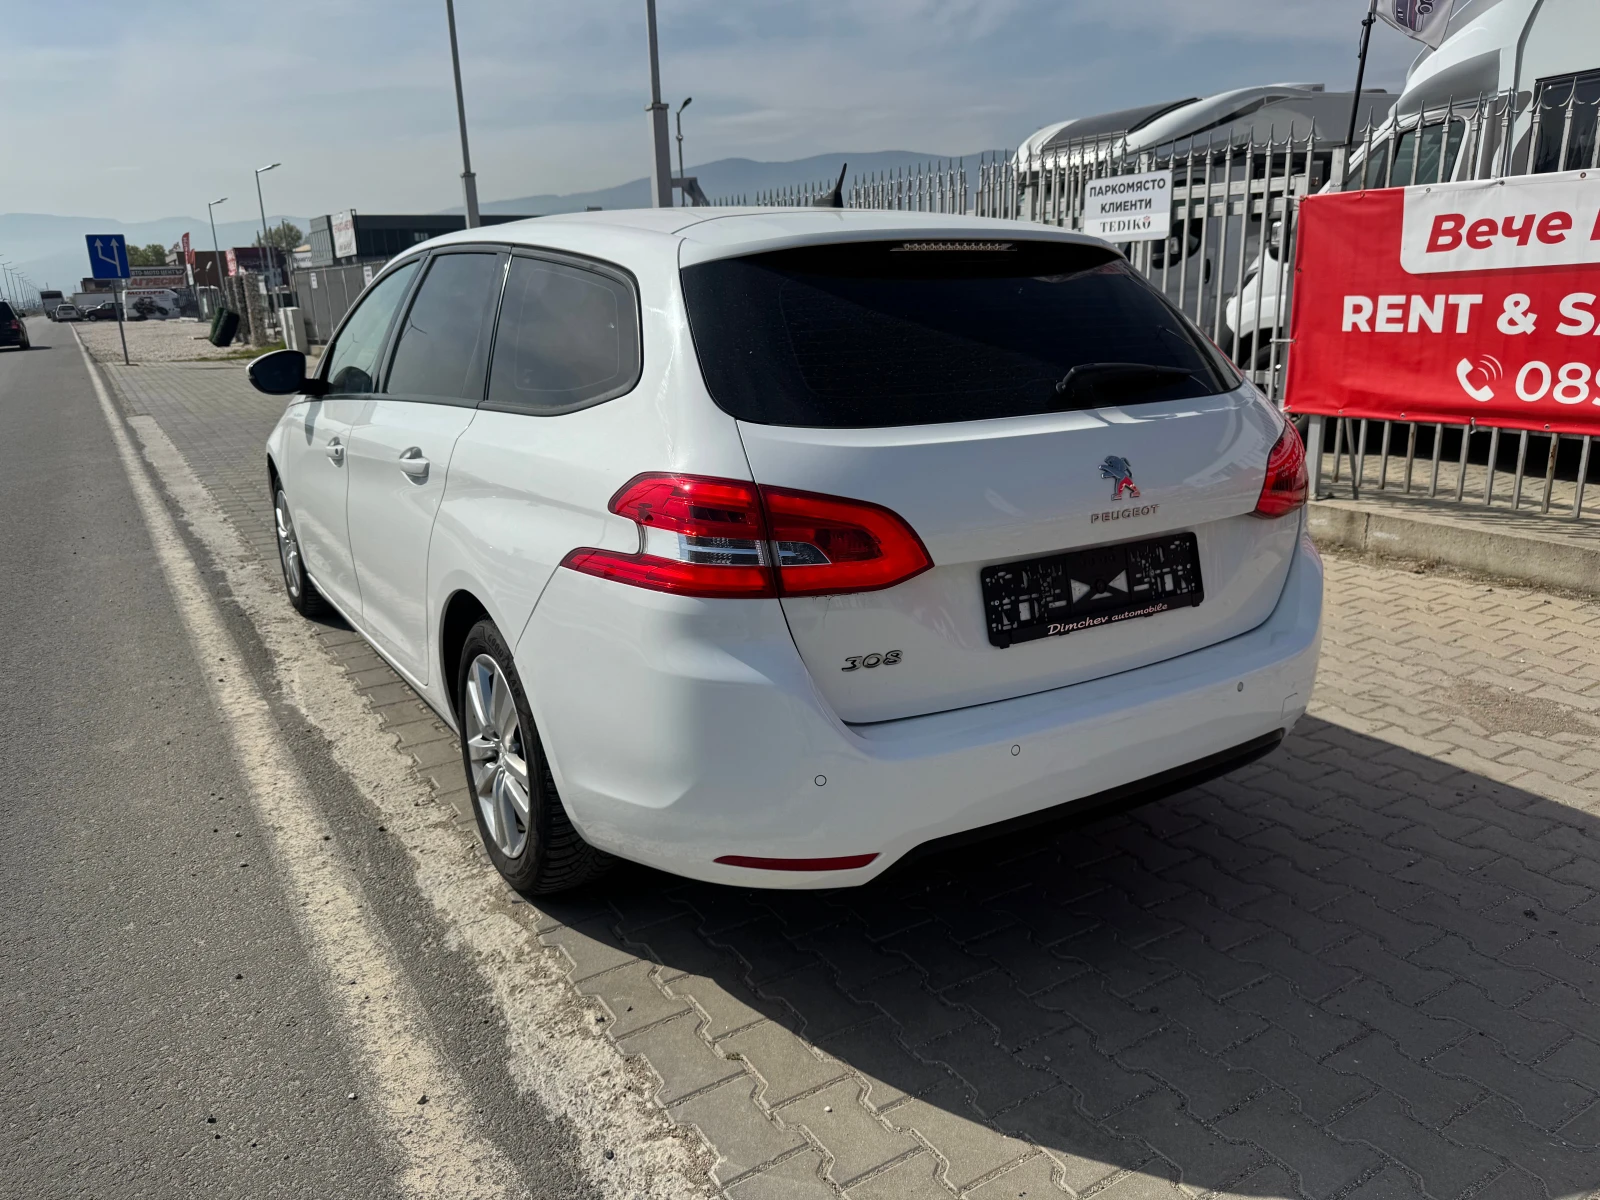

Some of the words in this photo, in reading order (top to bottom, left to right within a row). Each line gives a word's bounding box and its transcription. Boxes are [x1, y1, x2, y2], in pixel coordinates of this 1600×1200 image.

[1089, 178, 1166, 198] ПАРКОМЯСТО
[1100, 198, 1152, 214] КЛИЕНТИ
[1100, 217, 1151, 233] TEDIKO
[1425, 211, 1573, 253] Вече
[1341, 294, 1483, 334] RENT
[1496, 292, 1538, 336] &
[1556, 292, 1600, 337] S
[1515, 360, 1600, 406] 08
[1091, 503, 1160, 524] PEUGEOT
[1047, 615, 1109, 636] Dimchev
[1111, 602, 1168, 621] automobile
[841, 649, 904, 673] 308
